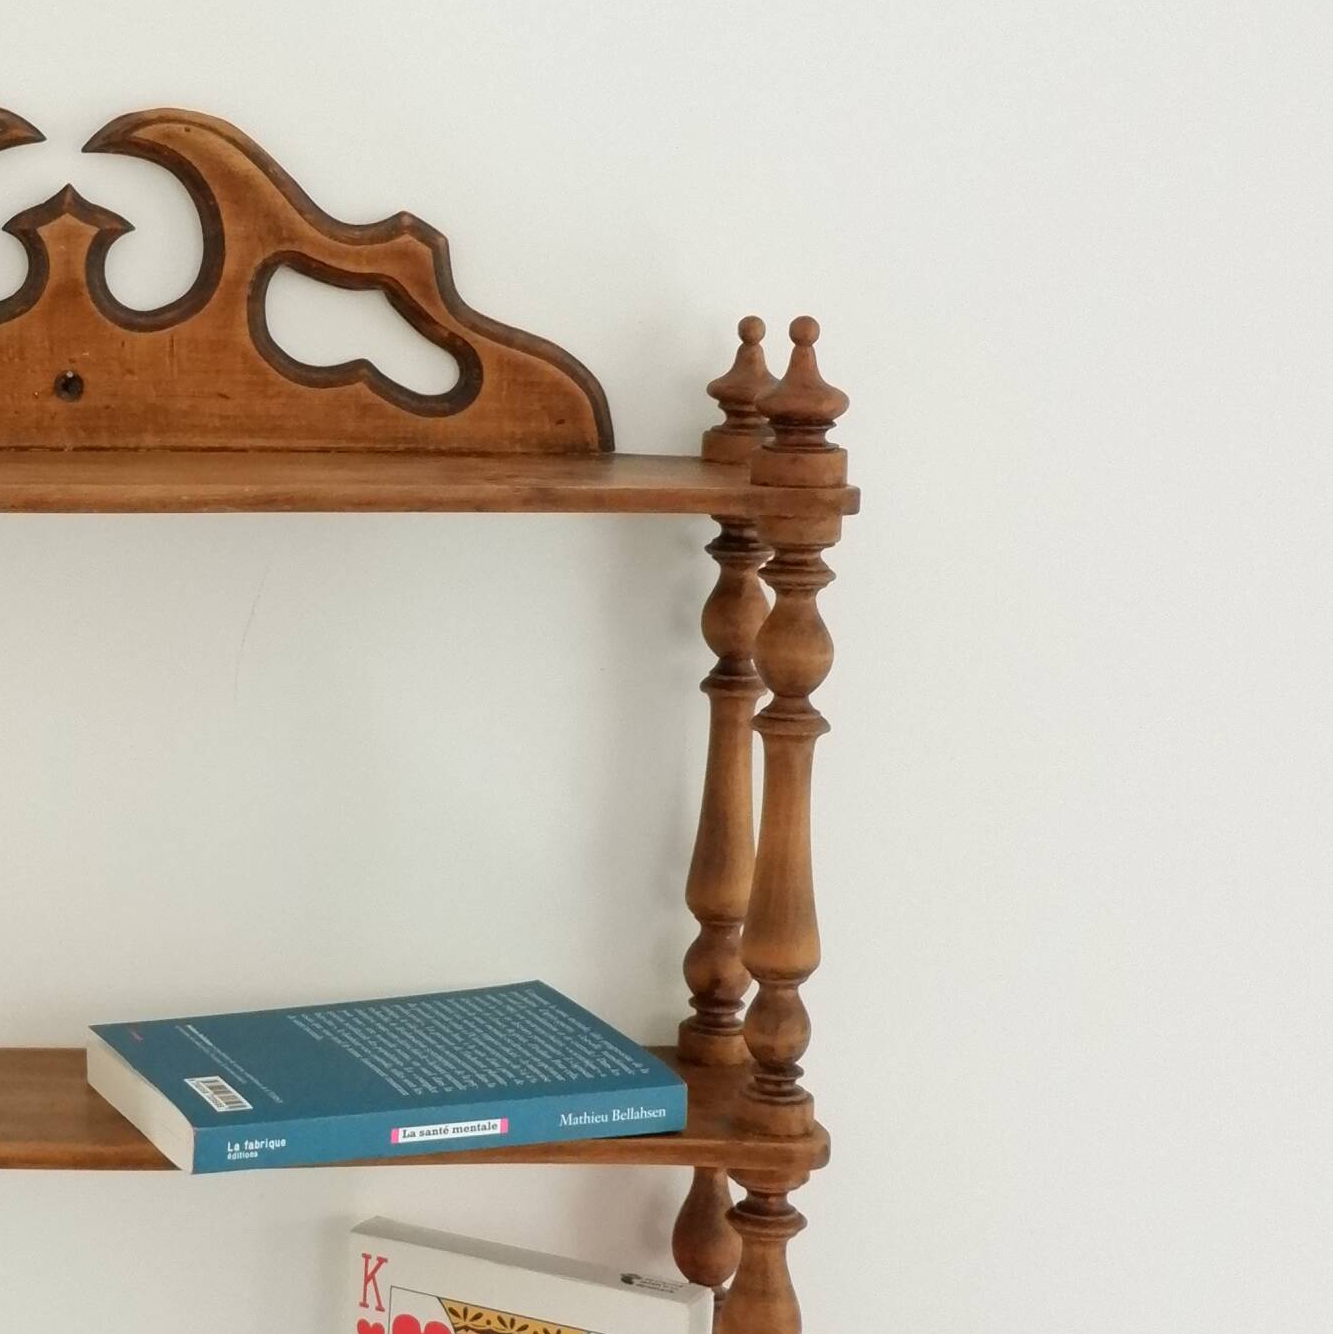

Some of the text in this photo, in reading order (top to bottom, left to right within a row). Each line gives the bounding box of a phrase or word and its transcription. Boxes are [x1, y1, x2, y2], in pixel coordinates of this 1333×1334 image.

[559, 1107, 667, 1127] Mathieu Bellahsen
[402, 1121, 498, 1139] La santé mentale
[227, 1137, 287, 1152] La fabrique
[359, 1253, 388, 1312] K
